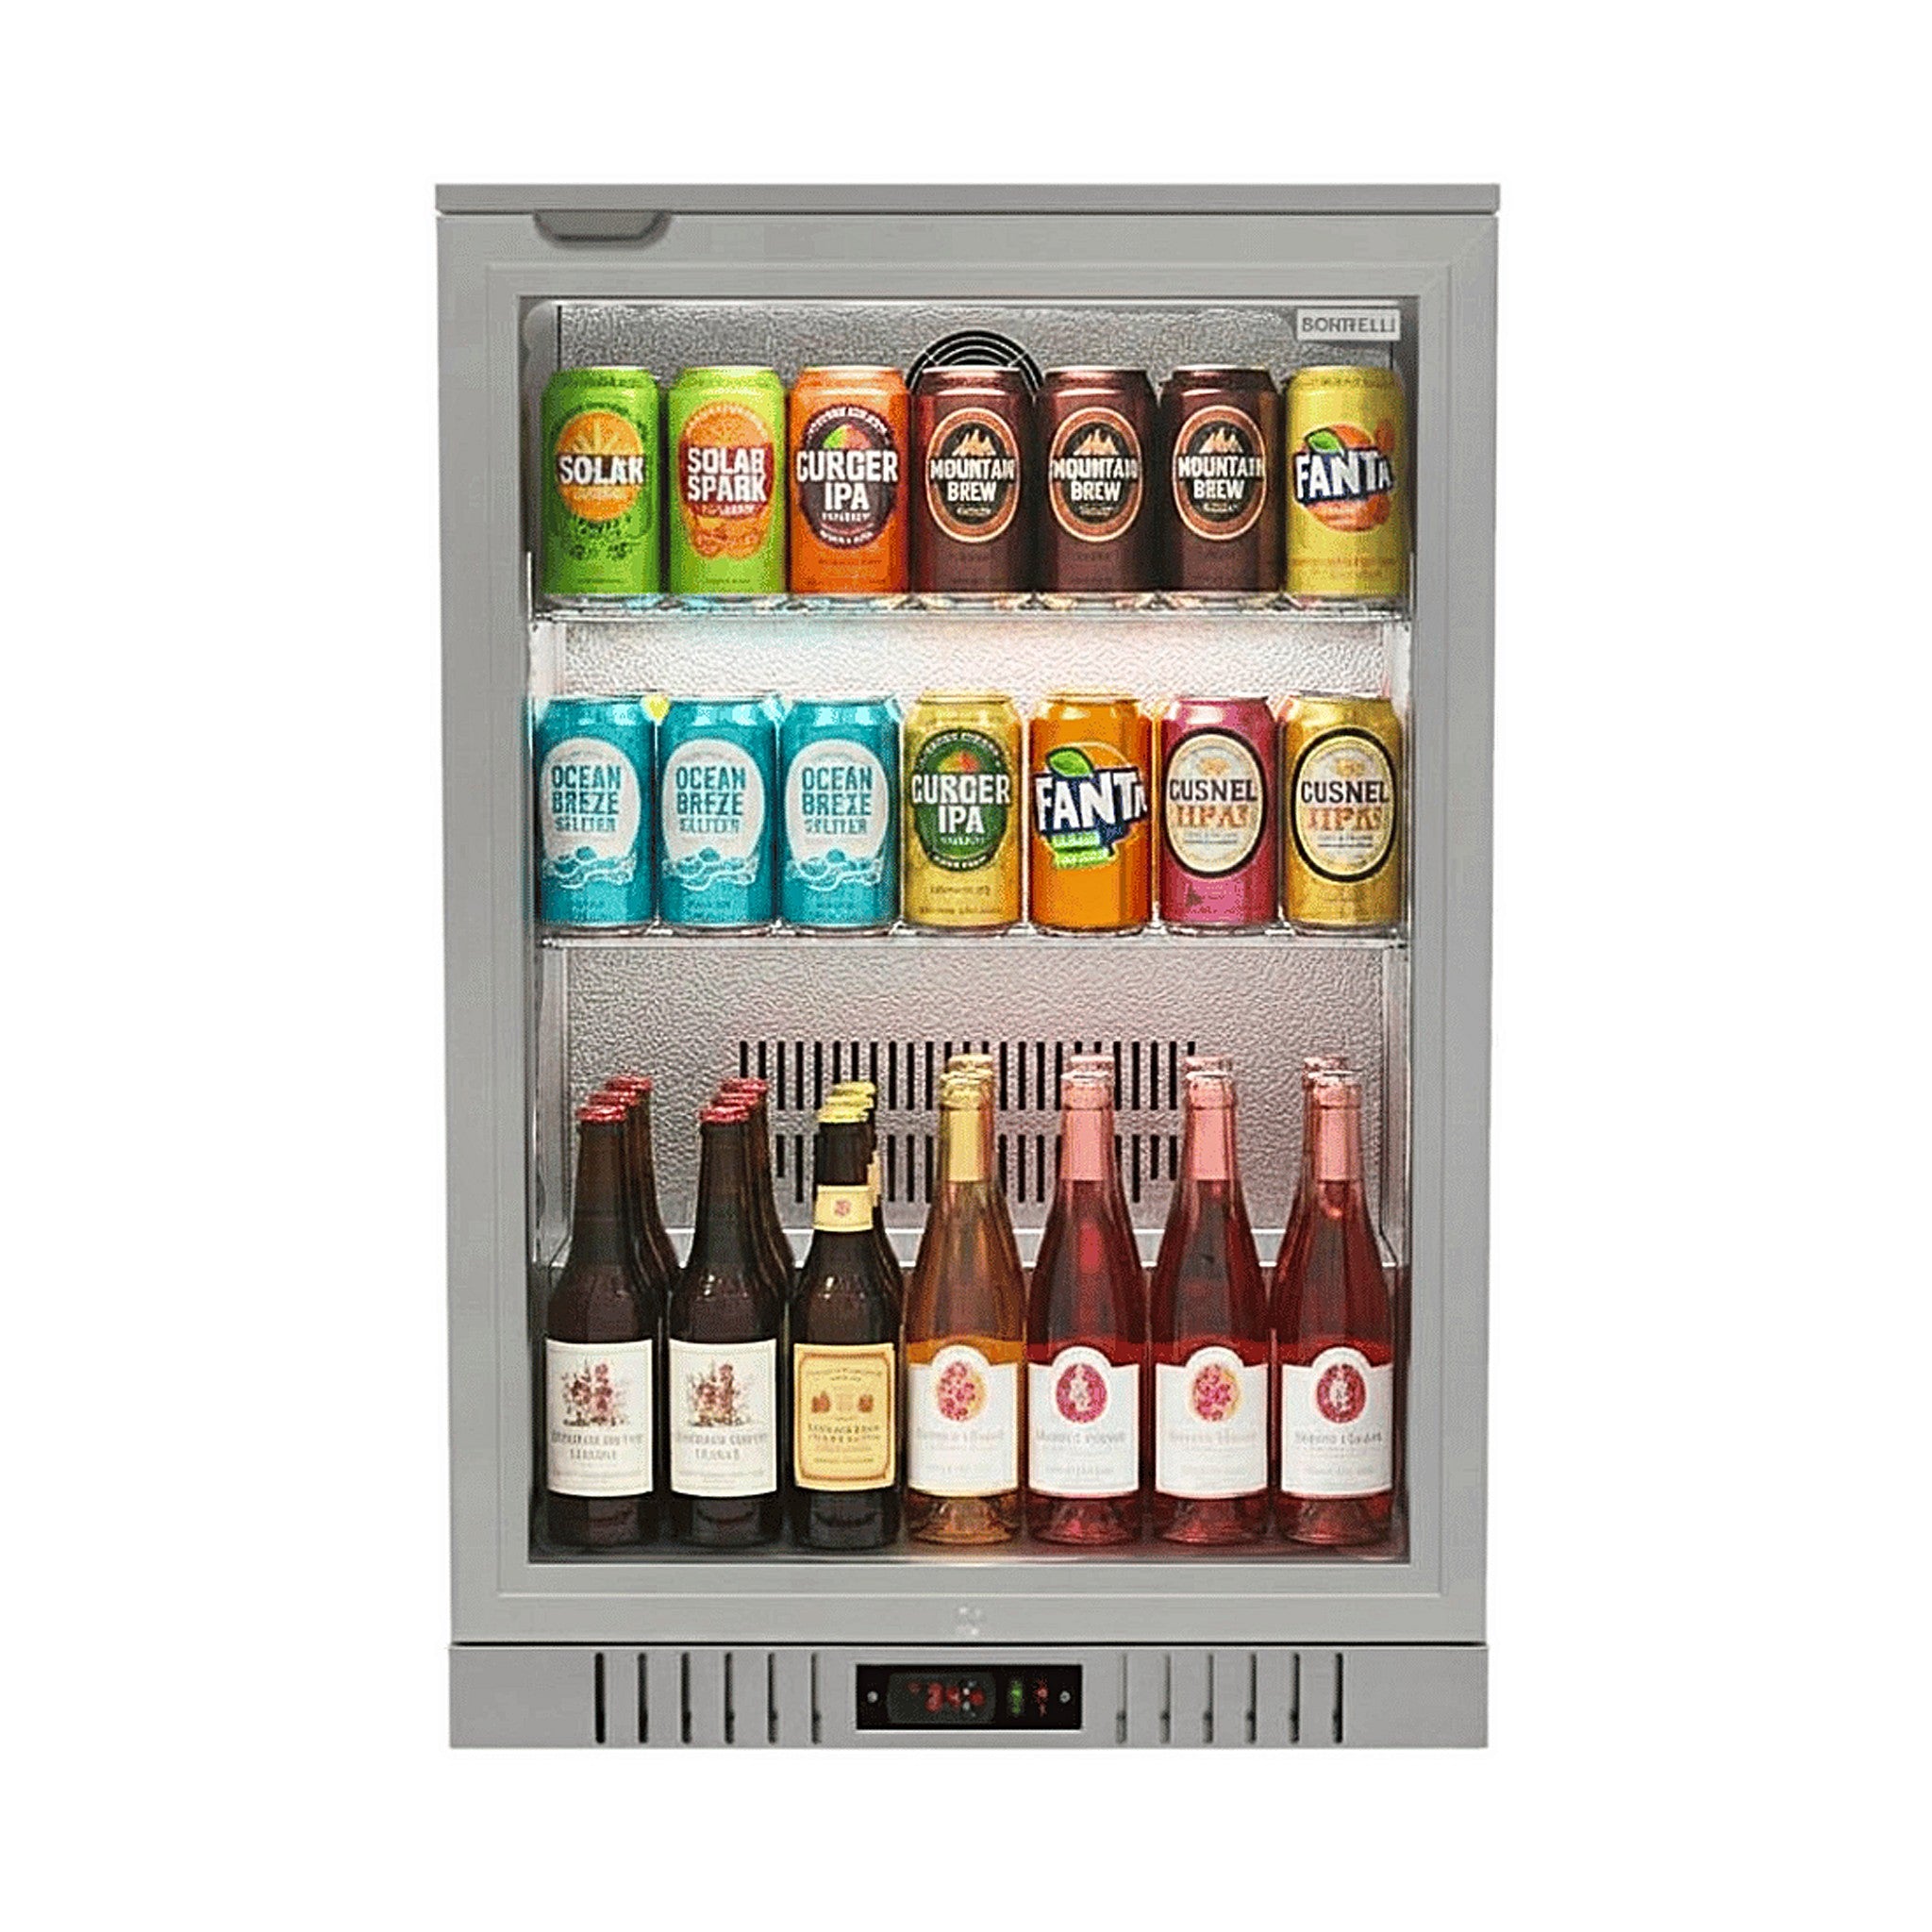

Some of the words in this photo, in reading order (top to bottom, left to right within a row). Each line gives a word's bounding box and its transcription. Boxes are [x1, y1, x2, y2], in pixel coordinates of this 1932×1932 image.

[1295, 451, 1391, 500] FANTA
[824, 482, 870, 510] IPA
[947, 481, 996, 501] BREW
[1071, 480, 1121, 501] BREW
[1193, 478, 1244, 499] BREW
[551, 764, 621, 789] OCEAN
[675, 766, 745, 790] OCEAN
[802, 765, 872, 791] OCEAN
[939, 806, 985, 833] IPA
